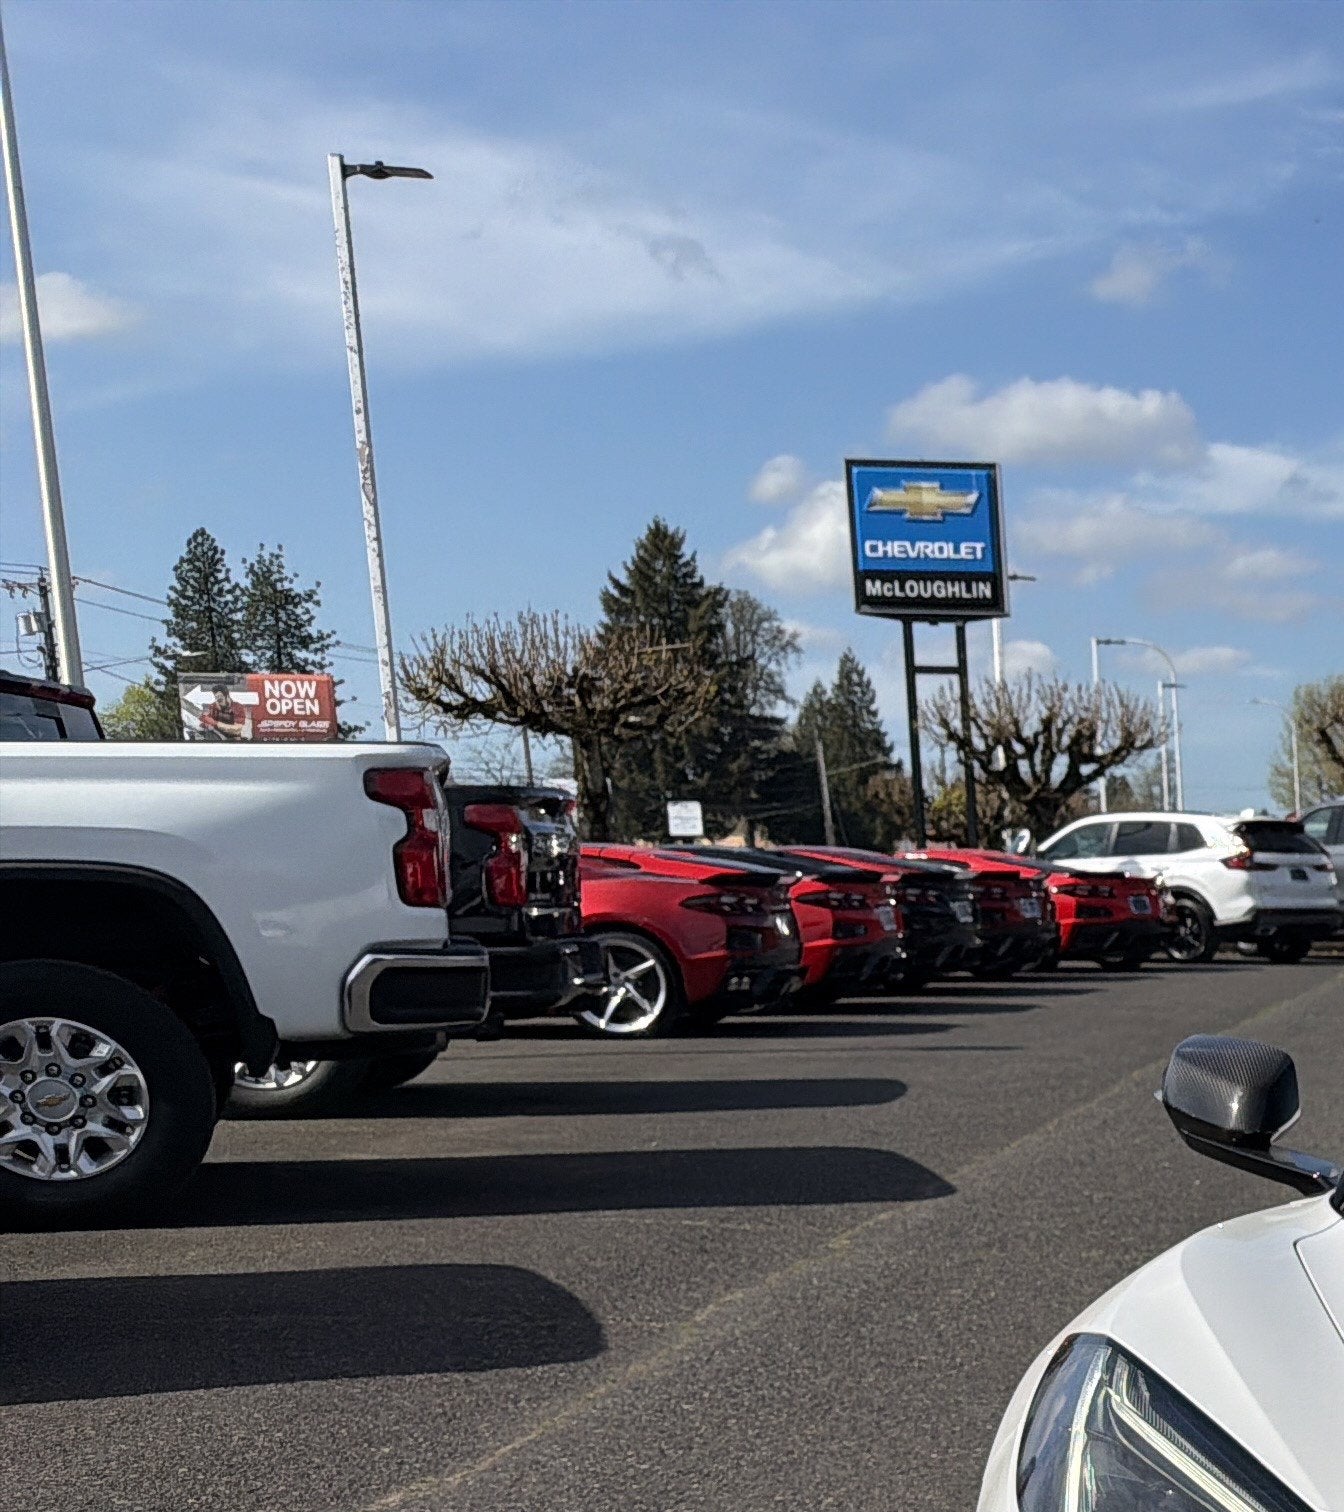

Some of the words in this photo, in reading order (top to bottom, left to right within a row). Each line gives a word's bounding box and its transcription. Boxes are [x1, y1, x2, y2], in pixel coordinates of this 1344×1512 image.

[864, 540, 985, 560] CHEVROLET
[865, 579, 992, 599] McLOUGHLIN
[264, 680, 317, 699] NOW
[265, 698, 320, 715] OPEN
